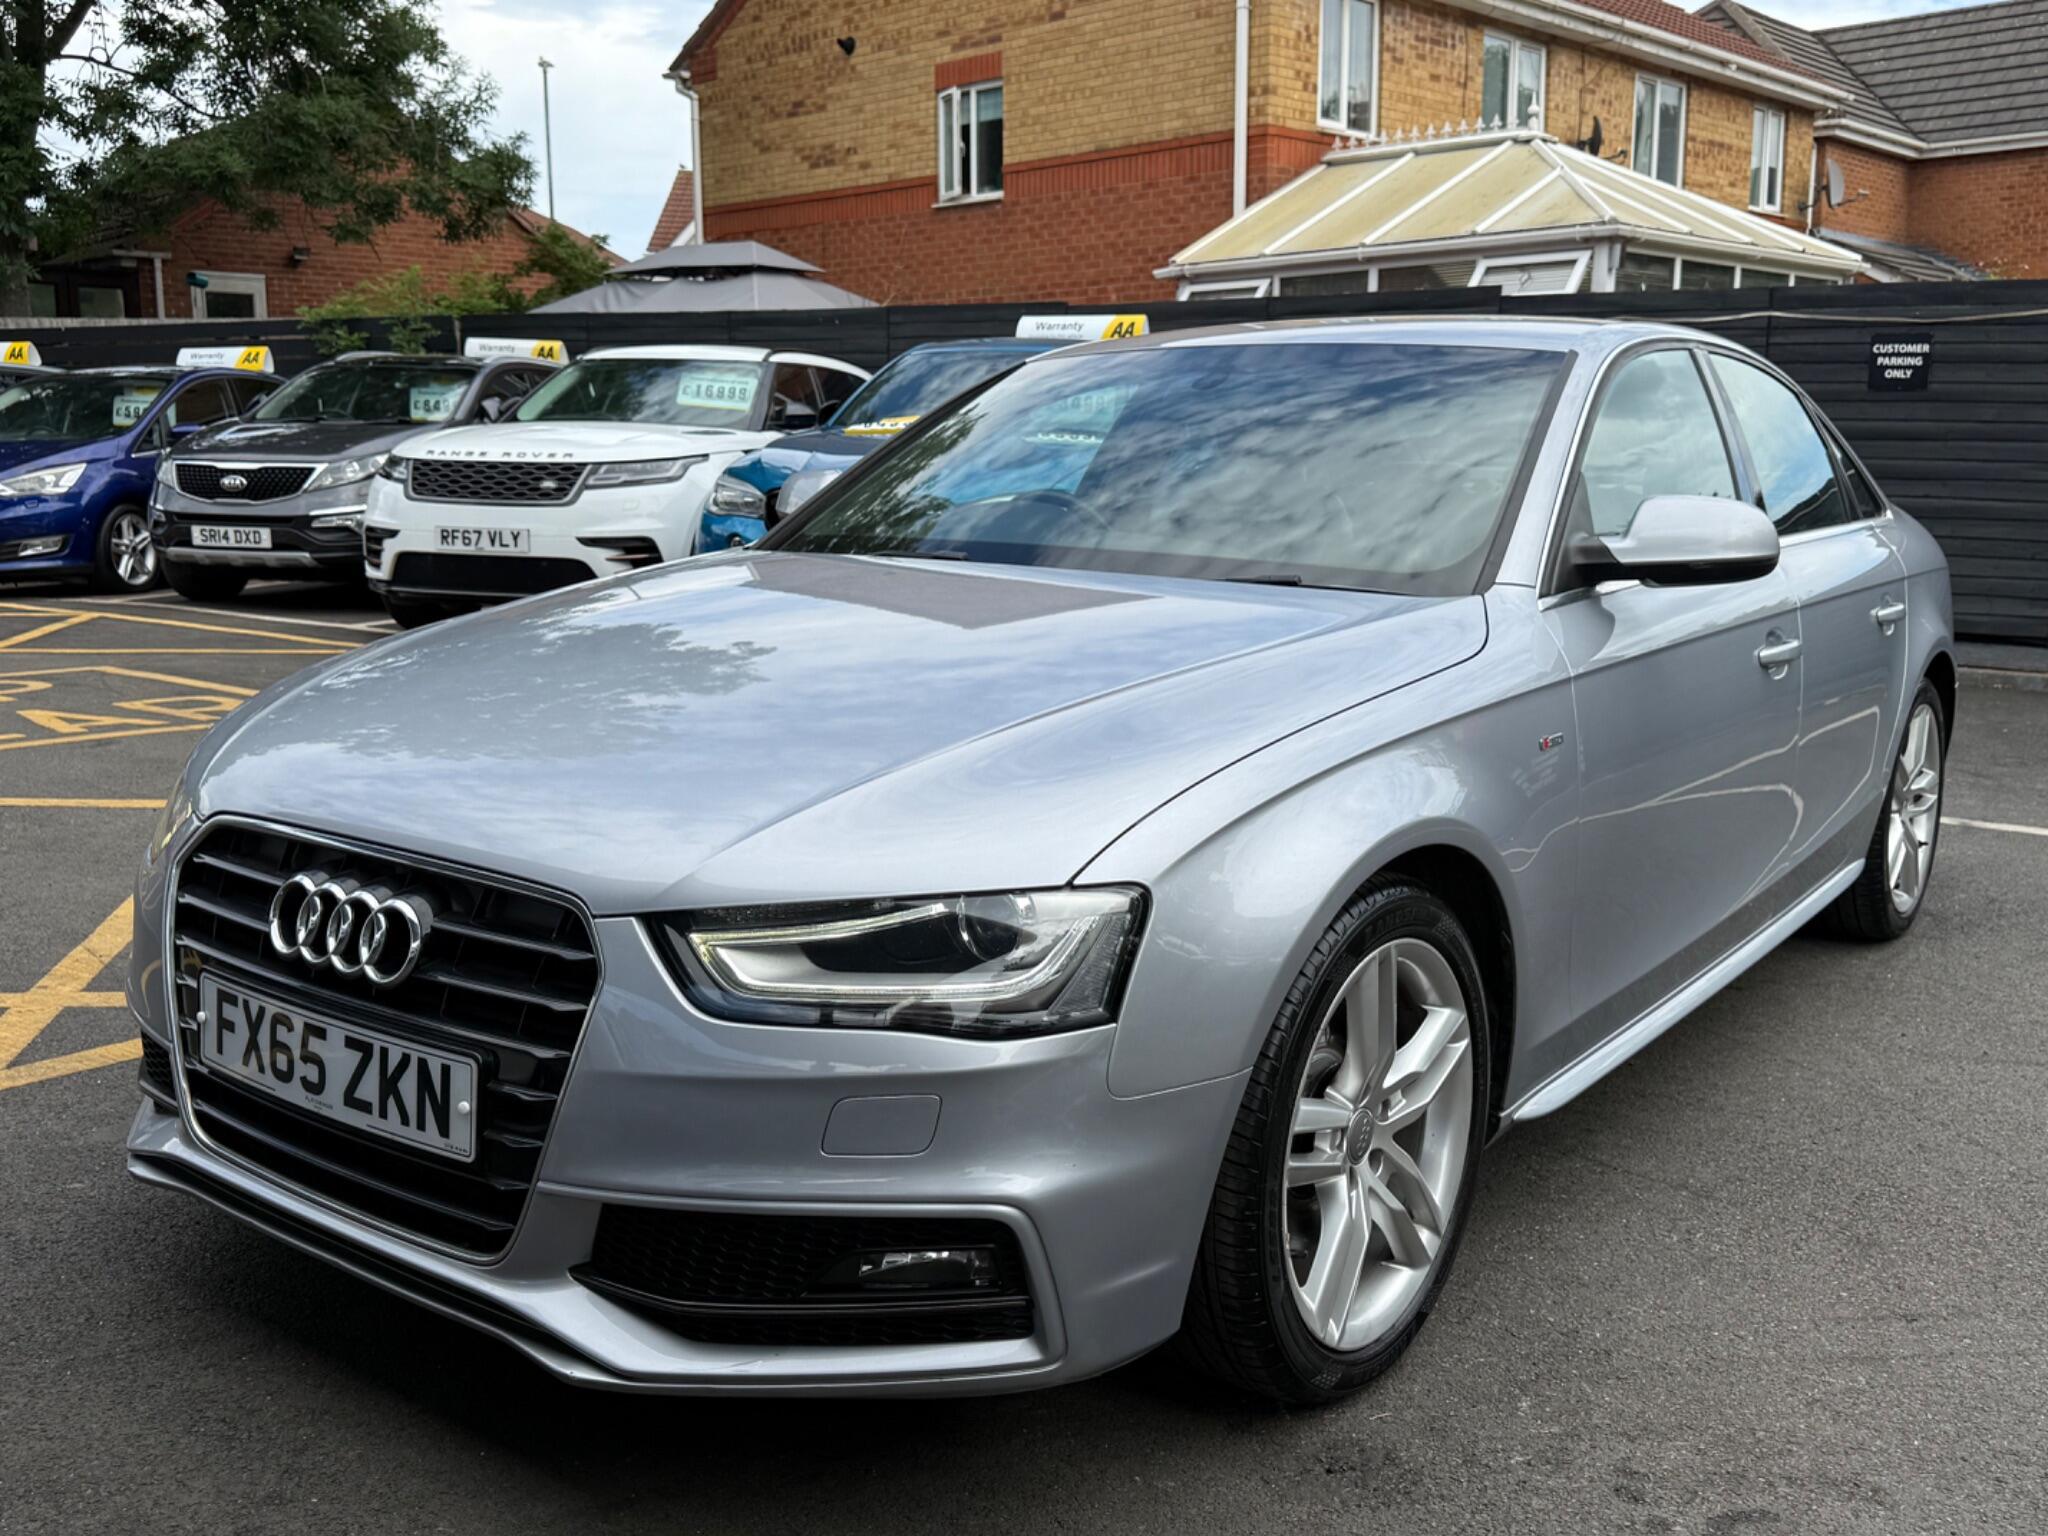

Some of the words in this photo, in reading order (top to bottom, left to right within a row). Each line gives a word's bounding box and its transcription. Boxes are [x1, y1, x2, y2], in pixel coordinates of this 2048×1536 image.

[1035, 321, 1085, 332] Warranty
[1110, 322, 1136, 338] AA
[8, 346, 25, 361] AA
[537, 346, 555, 360] AA
[1872, 343, 1930, 354] CUSTOMER
[242, 351, 260, 364] AA
[1876, 355, 1923, 366] PARKING
[1884, 368, 1913, 379] ONLY
[426, 449, 488, 457] RANGE
[502, 451, 574, 459] ROVER
[199, 528, 230, 544] SR14
[233, 529, 262, 545] DXD
[440, 528, 483, 547] RF67
[488, 530, 521, 548] VLY
[215, 986, 328, 1096] FX65
[343, 1034, 451, 1140] ZKN
